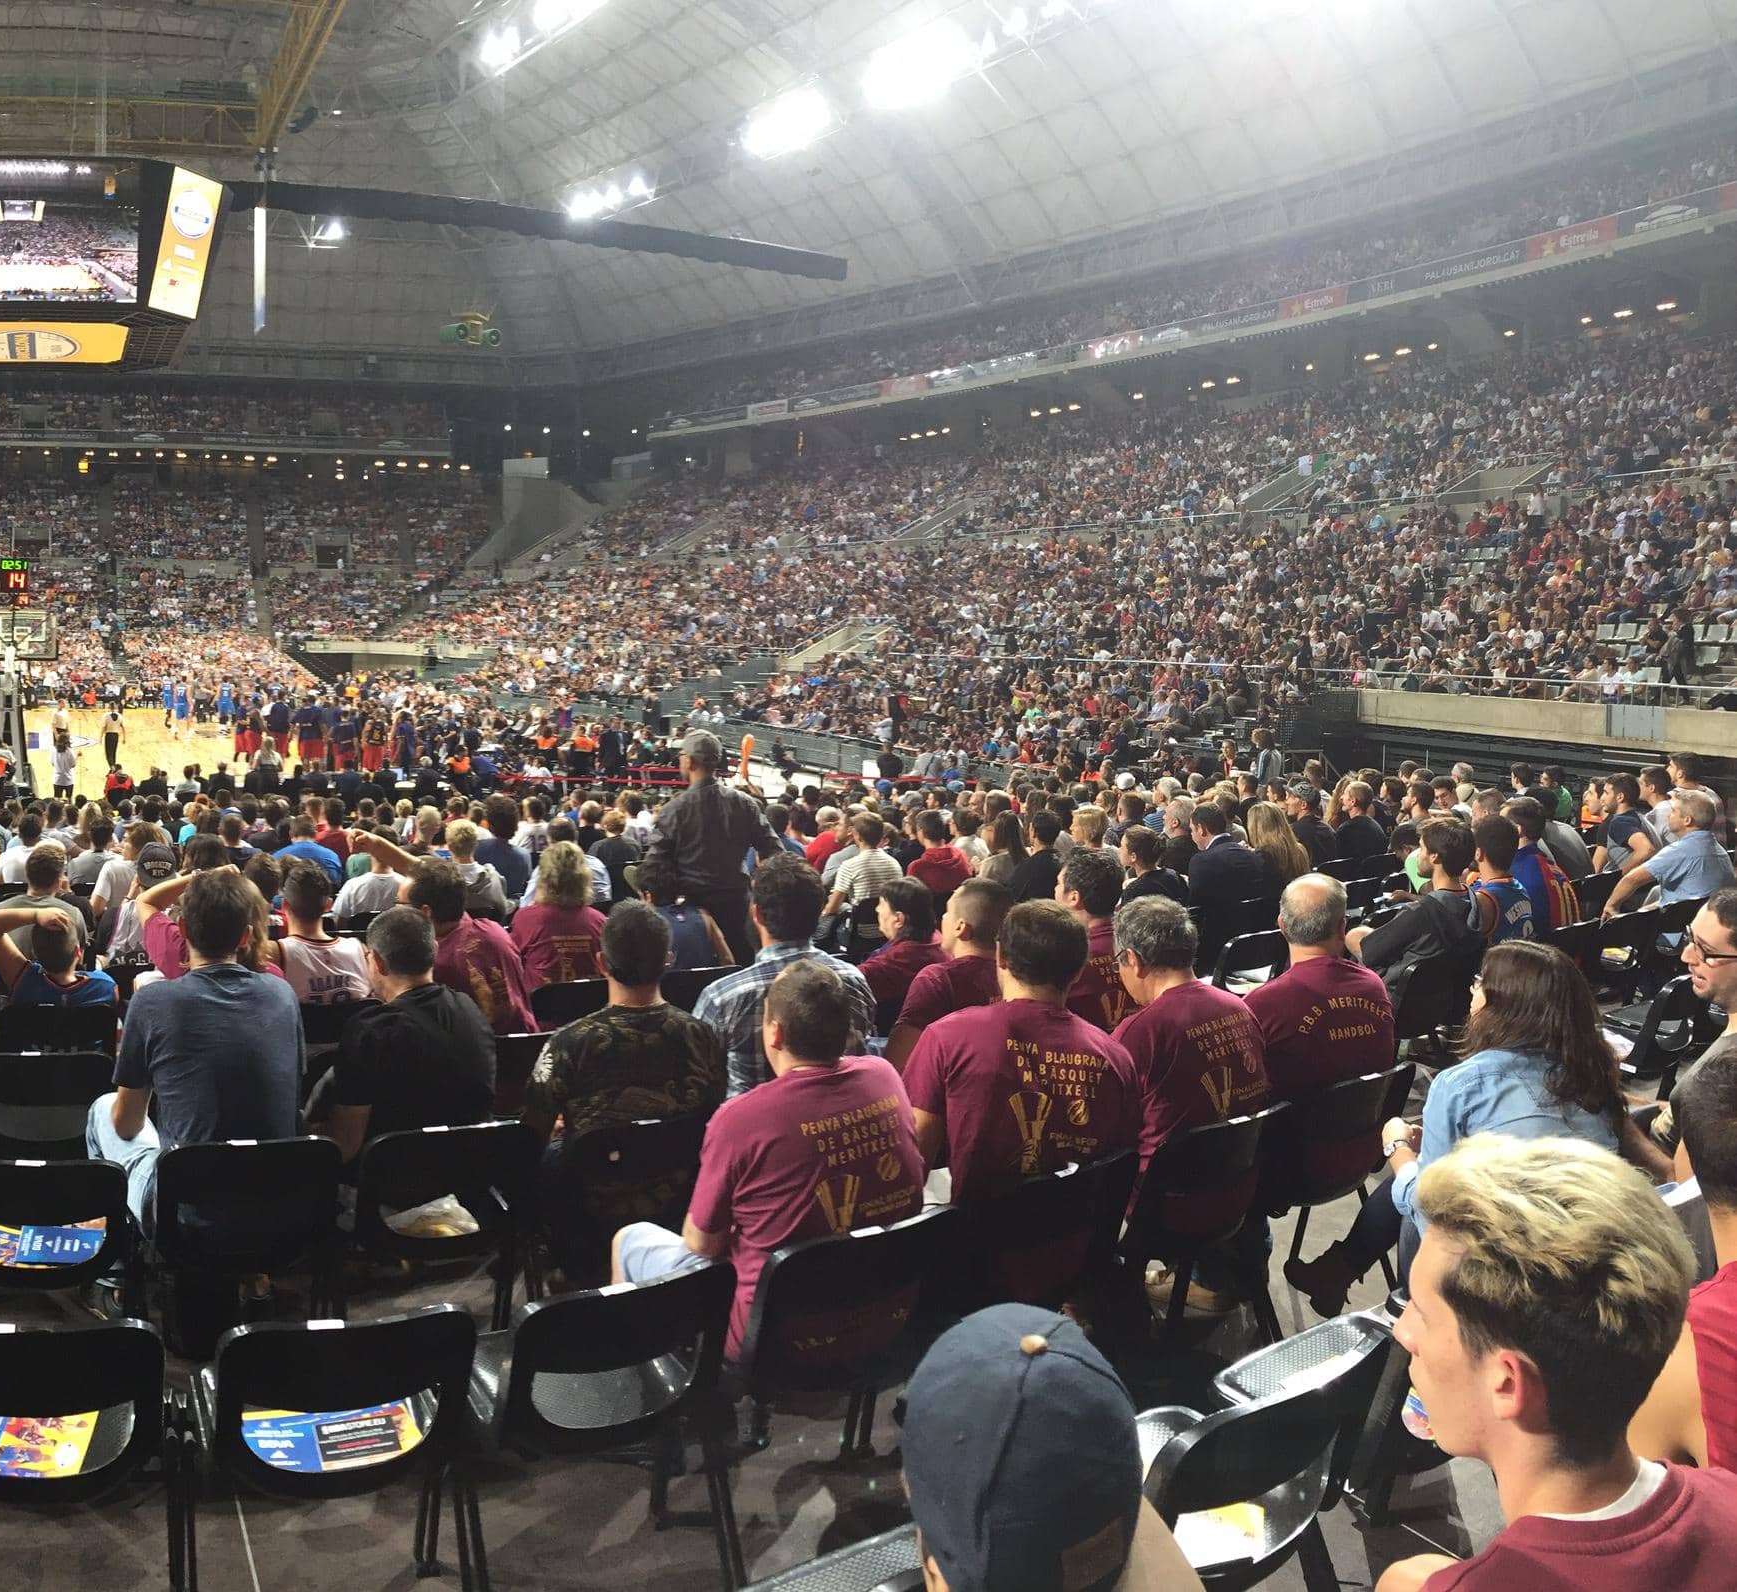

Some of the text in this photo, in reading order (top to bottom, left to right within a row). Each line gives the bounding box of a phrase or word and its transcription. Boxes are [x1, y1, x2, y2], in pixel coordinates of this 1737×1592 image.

[9, 572, 26, 588] 14
[1329, 1024, 1377, 1041] HANDBOL
[800, 1117, 842, 1136] PENYA
[817, 1137, 836, 1152] DE
